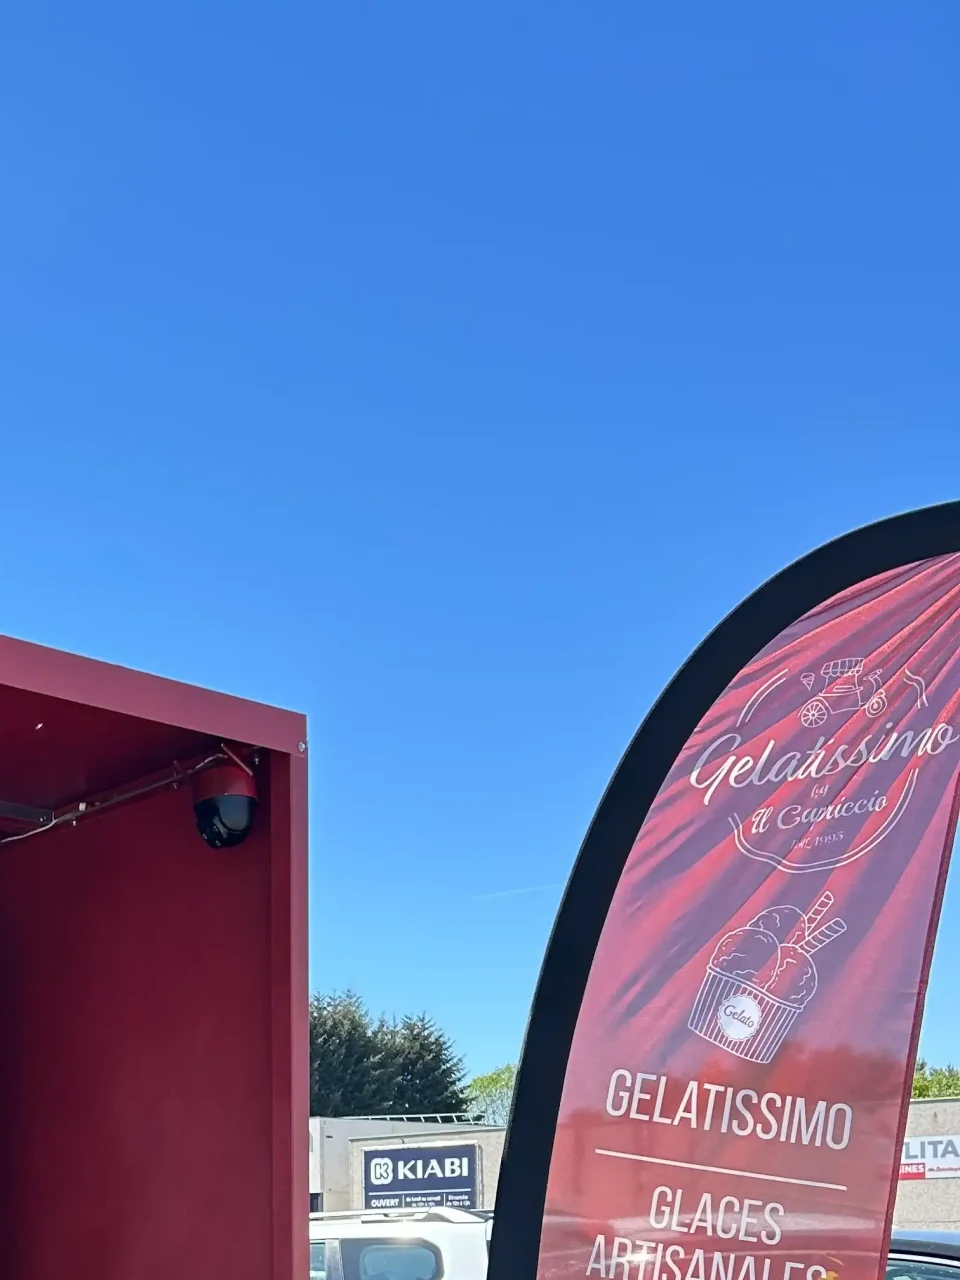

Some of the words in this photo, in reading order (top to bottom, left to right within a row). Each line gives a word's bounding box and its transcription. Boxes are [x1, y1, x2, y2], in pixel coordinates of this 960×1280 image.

[689, 720, 959, 805] Gelatissimo
[777, 790, 888, 830] Capriccio
[722, 1003, 756, 1029] Gelato
[604, 1068, 854, 1151] GELATISSIMO
[397, 1157, 469, 1180] KIABI
[371, 1198, 399, 1207] OUVERT
[648, 1184, 786, 1246] GLACES
